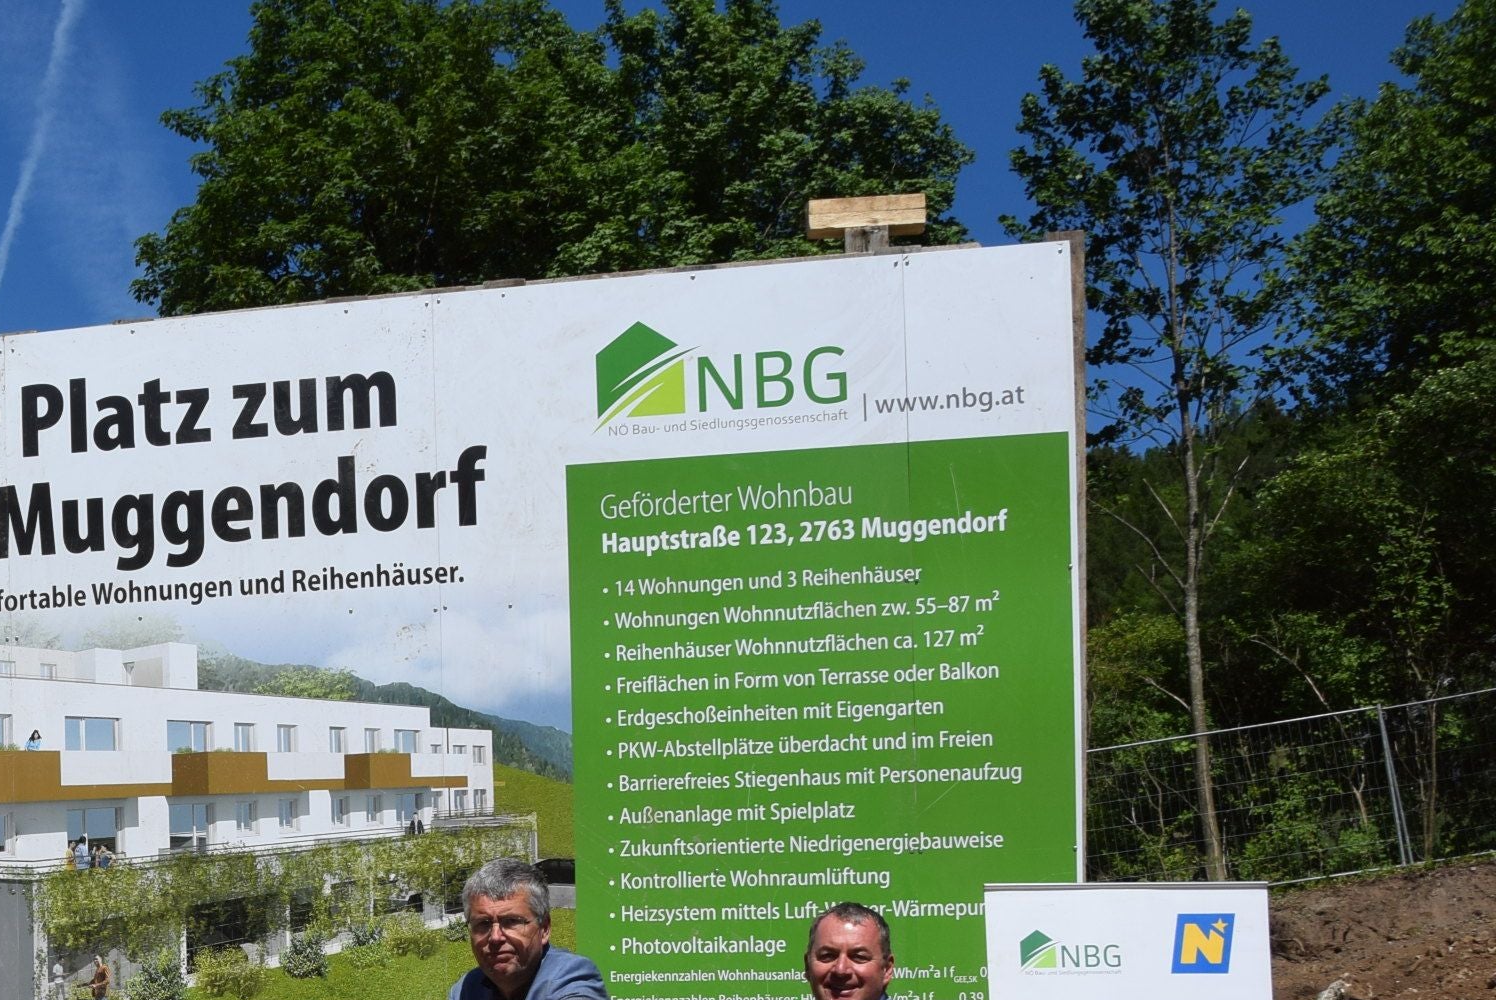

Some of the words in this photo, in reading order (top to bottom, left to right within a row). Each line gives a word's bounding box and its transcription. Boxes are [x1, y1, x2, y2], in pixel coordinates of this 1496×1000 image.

[697, 346, 848, 412] NBG
[21, 376, 212, 458] Platz
[232, 370, 398, 441] zum
[875, 385, 1024, 415] www.nbg.at
[608, 424, 629, 437] NÖ
[632, 423, 661, 435] Bau-
[663, 419, 687, 432] und
[690, 410, 848, 431] Siedlungsgenossenschaft
[600, 485, 732, 520] Geförderter
[737, 480, 852, 511] Wohnbau
[602, 522, 740, 556] Hauptstraße
[747, 523, 793, 548] 123,
[799, 519, 855, 544] 2763
[861, 509, 1007, 543] Muggendorf
[91, 578, 233, 609] Wohnungen
[239, 570, 286, 596] und
[291, 563, 465, 593] Reihenhäuser.
[615, 580, 635, 597] 14
[638, 574, 744, 596] Wohnungen
[748, 572, 782, 590] und
[787, 572, 797, 588] 3
[802, 565, 922, 588] Reihenhäuser
[615, 609, 720, 631] Wohnungen
[723, 600, 877, 624] Wohnnutzflächen
[881, 602, 911, 616] zw.
[616, 641, 731, 662] Reihenhäuser
[734, 634, 889, 657] Wohnnutzflächen
[893, 631, 918, 650] ca.
[923, 630, 956, 648] 127
[617, 675, 708, 694] Freiflächen
[713, 673, 730, 691] in
[734, 670, 778, 689] Form
[783, 671, 815, 686] von
[819, 666, 890, 685] Terrasse
[893, 664, 935, 682] oder
[940, 662, 999, 680] Balkon
[617, 703, 799, 728] Erdgeschoßeinheiten
[803, 702, 833, 719] mit
[836, 699, 944, 720] Eigengarten
[618, 737, 774, 760] PKW-Abstellplätze
[778, 733, 868, 754] überdacht
[872, 732, 907, 750] und
[912, 731, 935, 748] im
[940, 731, 993, 748] Freien
[619, 772, 730, 792] Barrierefreies
[734, 767, 842, 790] Stiegenhaus
[846, 767, 875, 784] mit
[880, 762, 1022, 784] Personenaufzug
[620, 804, 732, 826] Außenanlage
[737, 803, 766, 821] mit
[770, 802, 855, 823] Spielplatz
[620, 836, 785, 857] Zukunftsorientierte
[789, 832, 1003, 855] Niedrigenergiebauweise
[621, 871, 726, 891] Kontrollierte
[730, 867, 890, 889] Wohnraumlüftung
[621, 902, 717, 925] Heizsystem
[721, 902, 780, 920] mittels
[621, 934, 786, 957] Photovoltaikanlage
[1061, 945, 1121, 968] NBG
[610, 969, 715, 985] Energiekennzahlen
[718, 968, 808, 983] Wohnhausanlag
